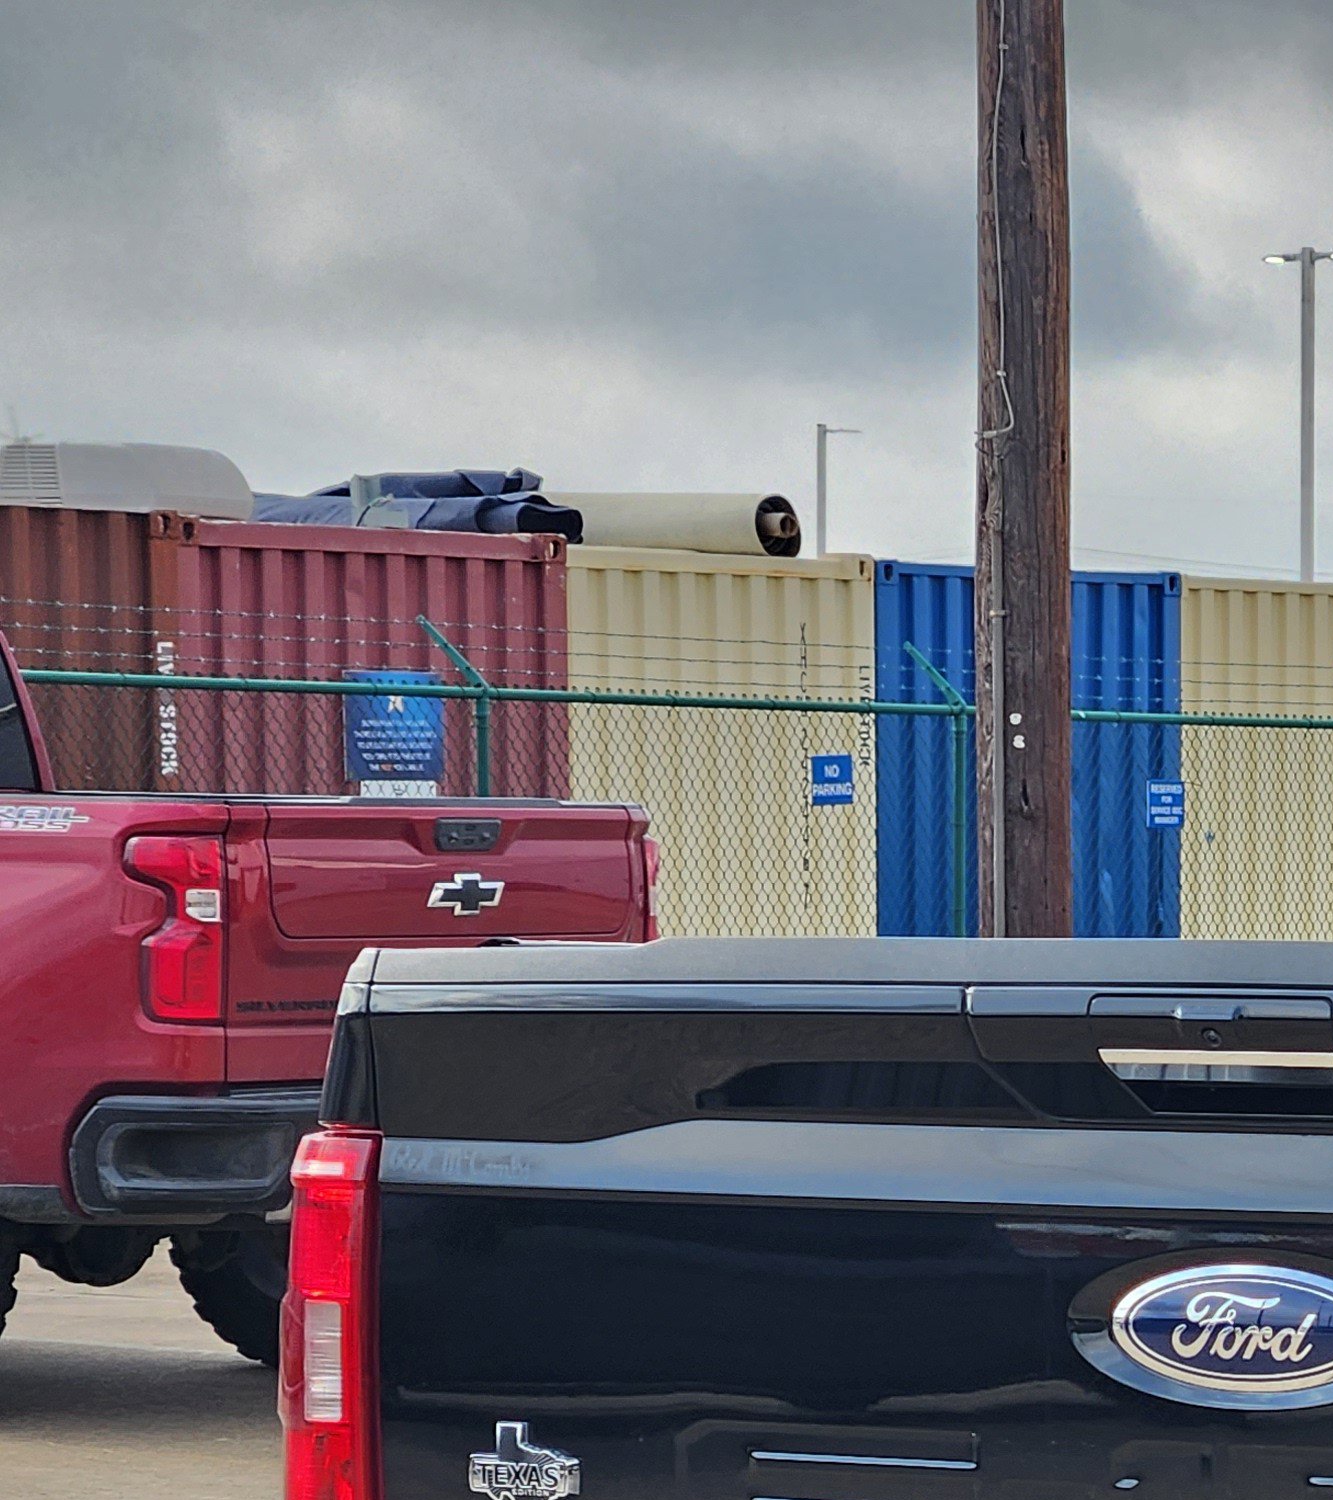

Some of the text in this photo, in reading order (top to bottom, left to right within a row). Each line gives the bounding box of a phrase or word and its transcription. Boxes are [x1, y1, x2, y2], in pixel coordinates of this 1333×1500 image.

[156, 641, 178, 775] LIVSTOCK
[823, 764, 840, 778] NO
[812, 782, 853, 797] PARKING
[1172, 1291, 1317, 1362] Ford
[479, 1462, 562, 1491] TEXAS
[511, 1488, 550, 1497] EDITION
